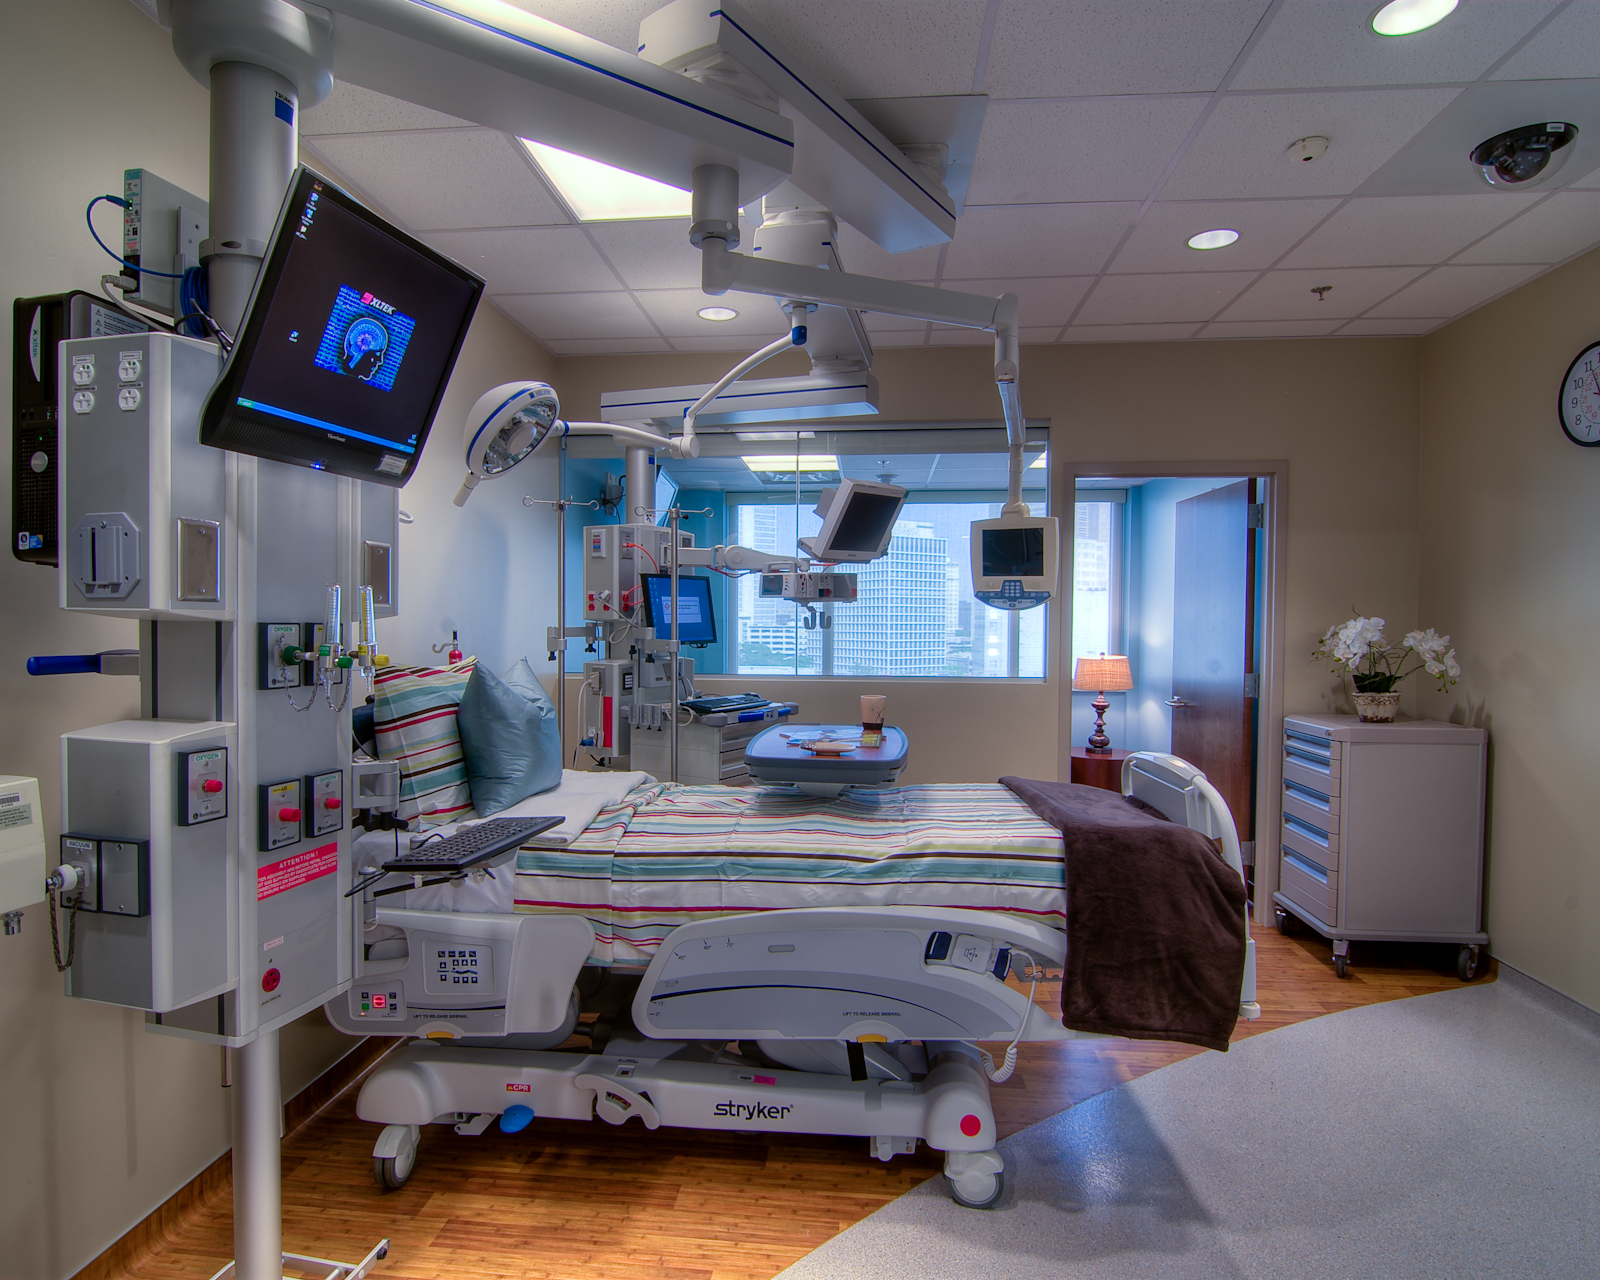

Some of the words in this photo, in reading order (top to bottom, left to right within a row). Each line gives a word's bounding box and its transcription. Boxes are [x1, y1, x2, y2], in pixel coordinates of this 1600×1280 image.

[370, 297, 397, 315] XLTEK
[1584, 360, 1593, 373] 11
[1573, 377, 1584, 390] 10
[1585, 382, 1592, 392] 22
[1571, 397, 1578, 409] 9
[1585, 405, 1593, 414] 20
[1575, 414, 1582, 426] 8
[1591, 411, 1598, 420] 19
[1585, 425, 1593, 436] 7
[195, 753, 219, 762] OXYGEN
[319, 775, 337, 783] OXYGEN
[68, 841, 91, 849] VACUUM
[279, 852, 315, 868] ATTENTION
[513, 1084, 529, 1092] CPR
[714, 1100, 791, 1120] stryker
